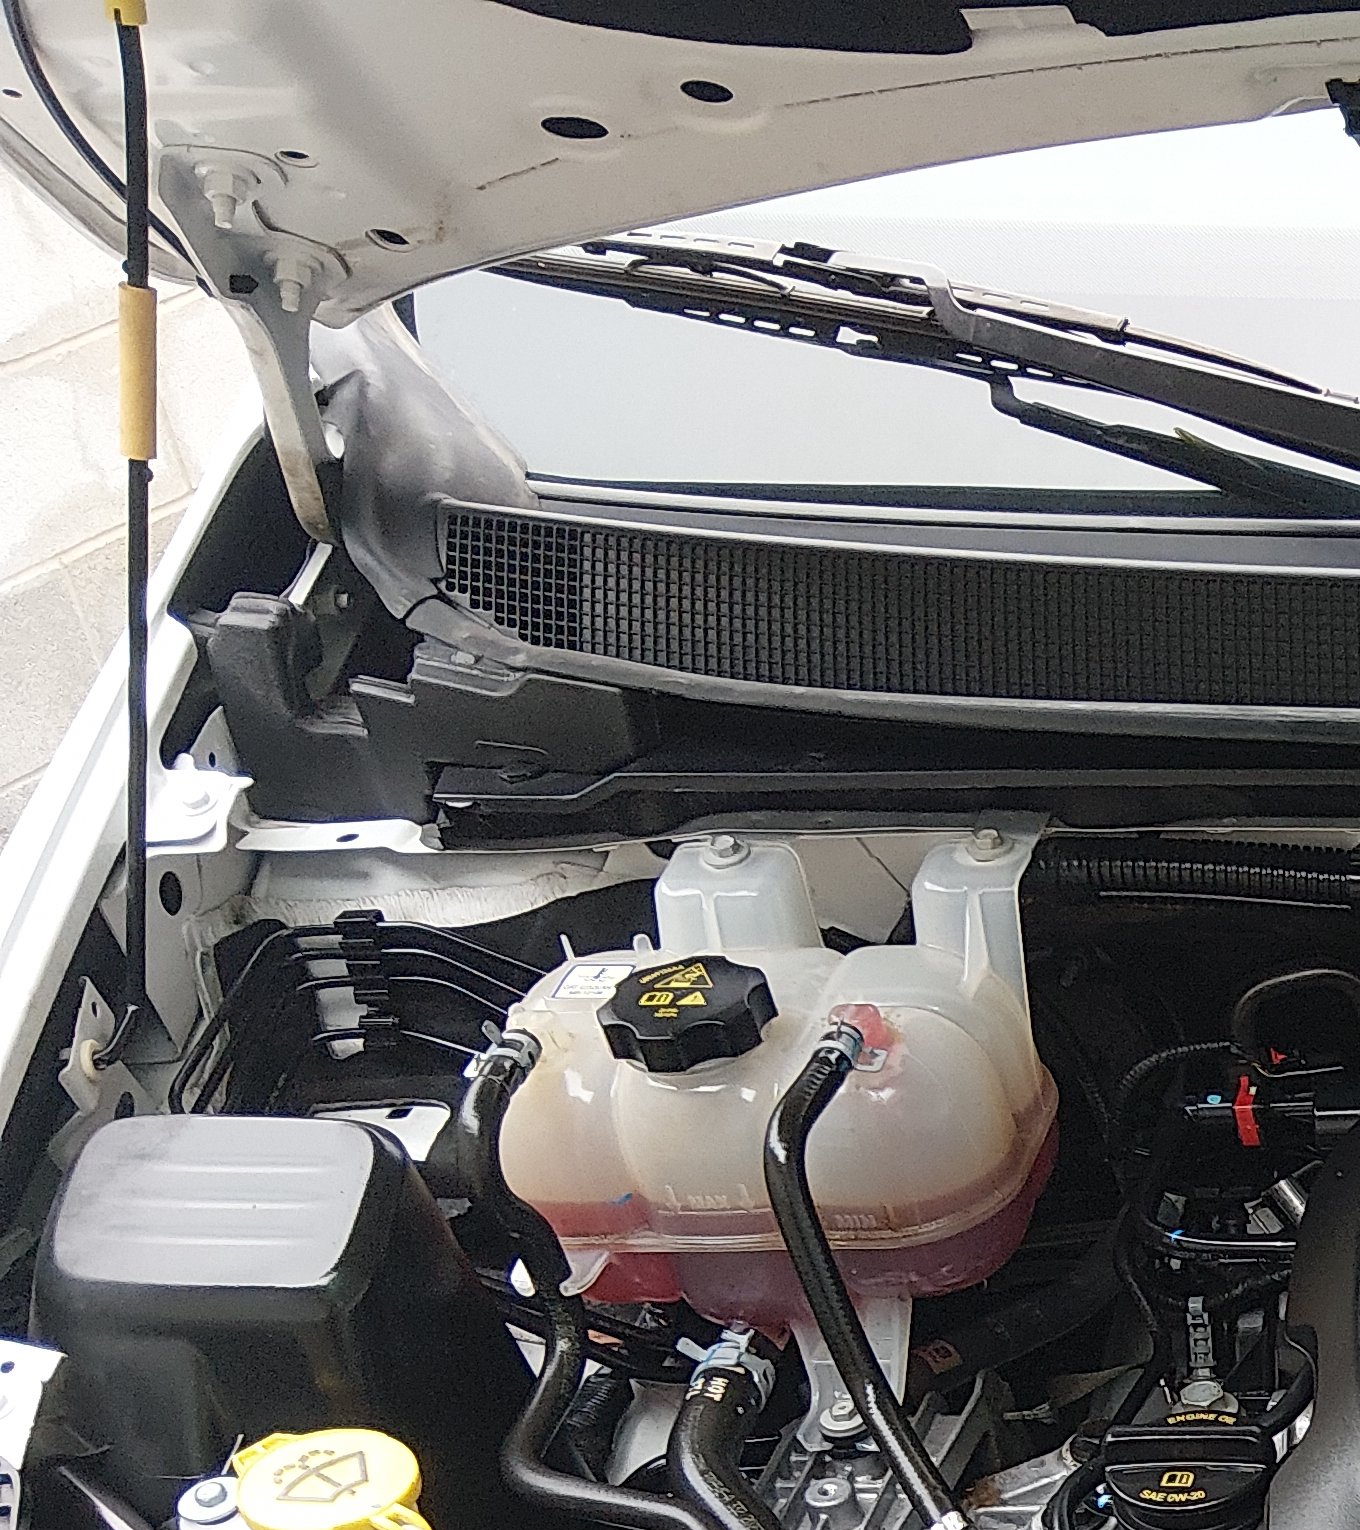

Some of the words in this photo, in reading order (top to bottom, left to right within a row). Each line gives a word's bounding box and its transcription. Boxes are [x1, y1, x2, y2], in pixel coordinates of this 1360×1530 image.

[686, 1194, 728, 1209] MAX
[834, 1213, 878, 1229] MIN
[706, 1376, 730, 1403] HOT
[1166, 1412, 1218, 1425] ENGINE
[1139, 1489, 1167, 1502] SAE
[1166, 1490, 1207, 1503] 0W-20
